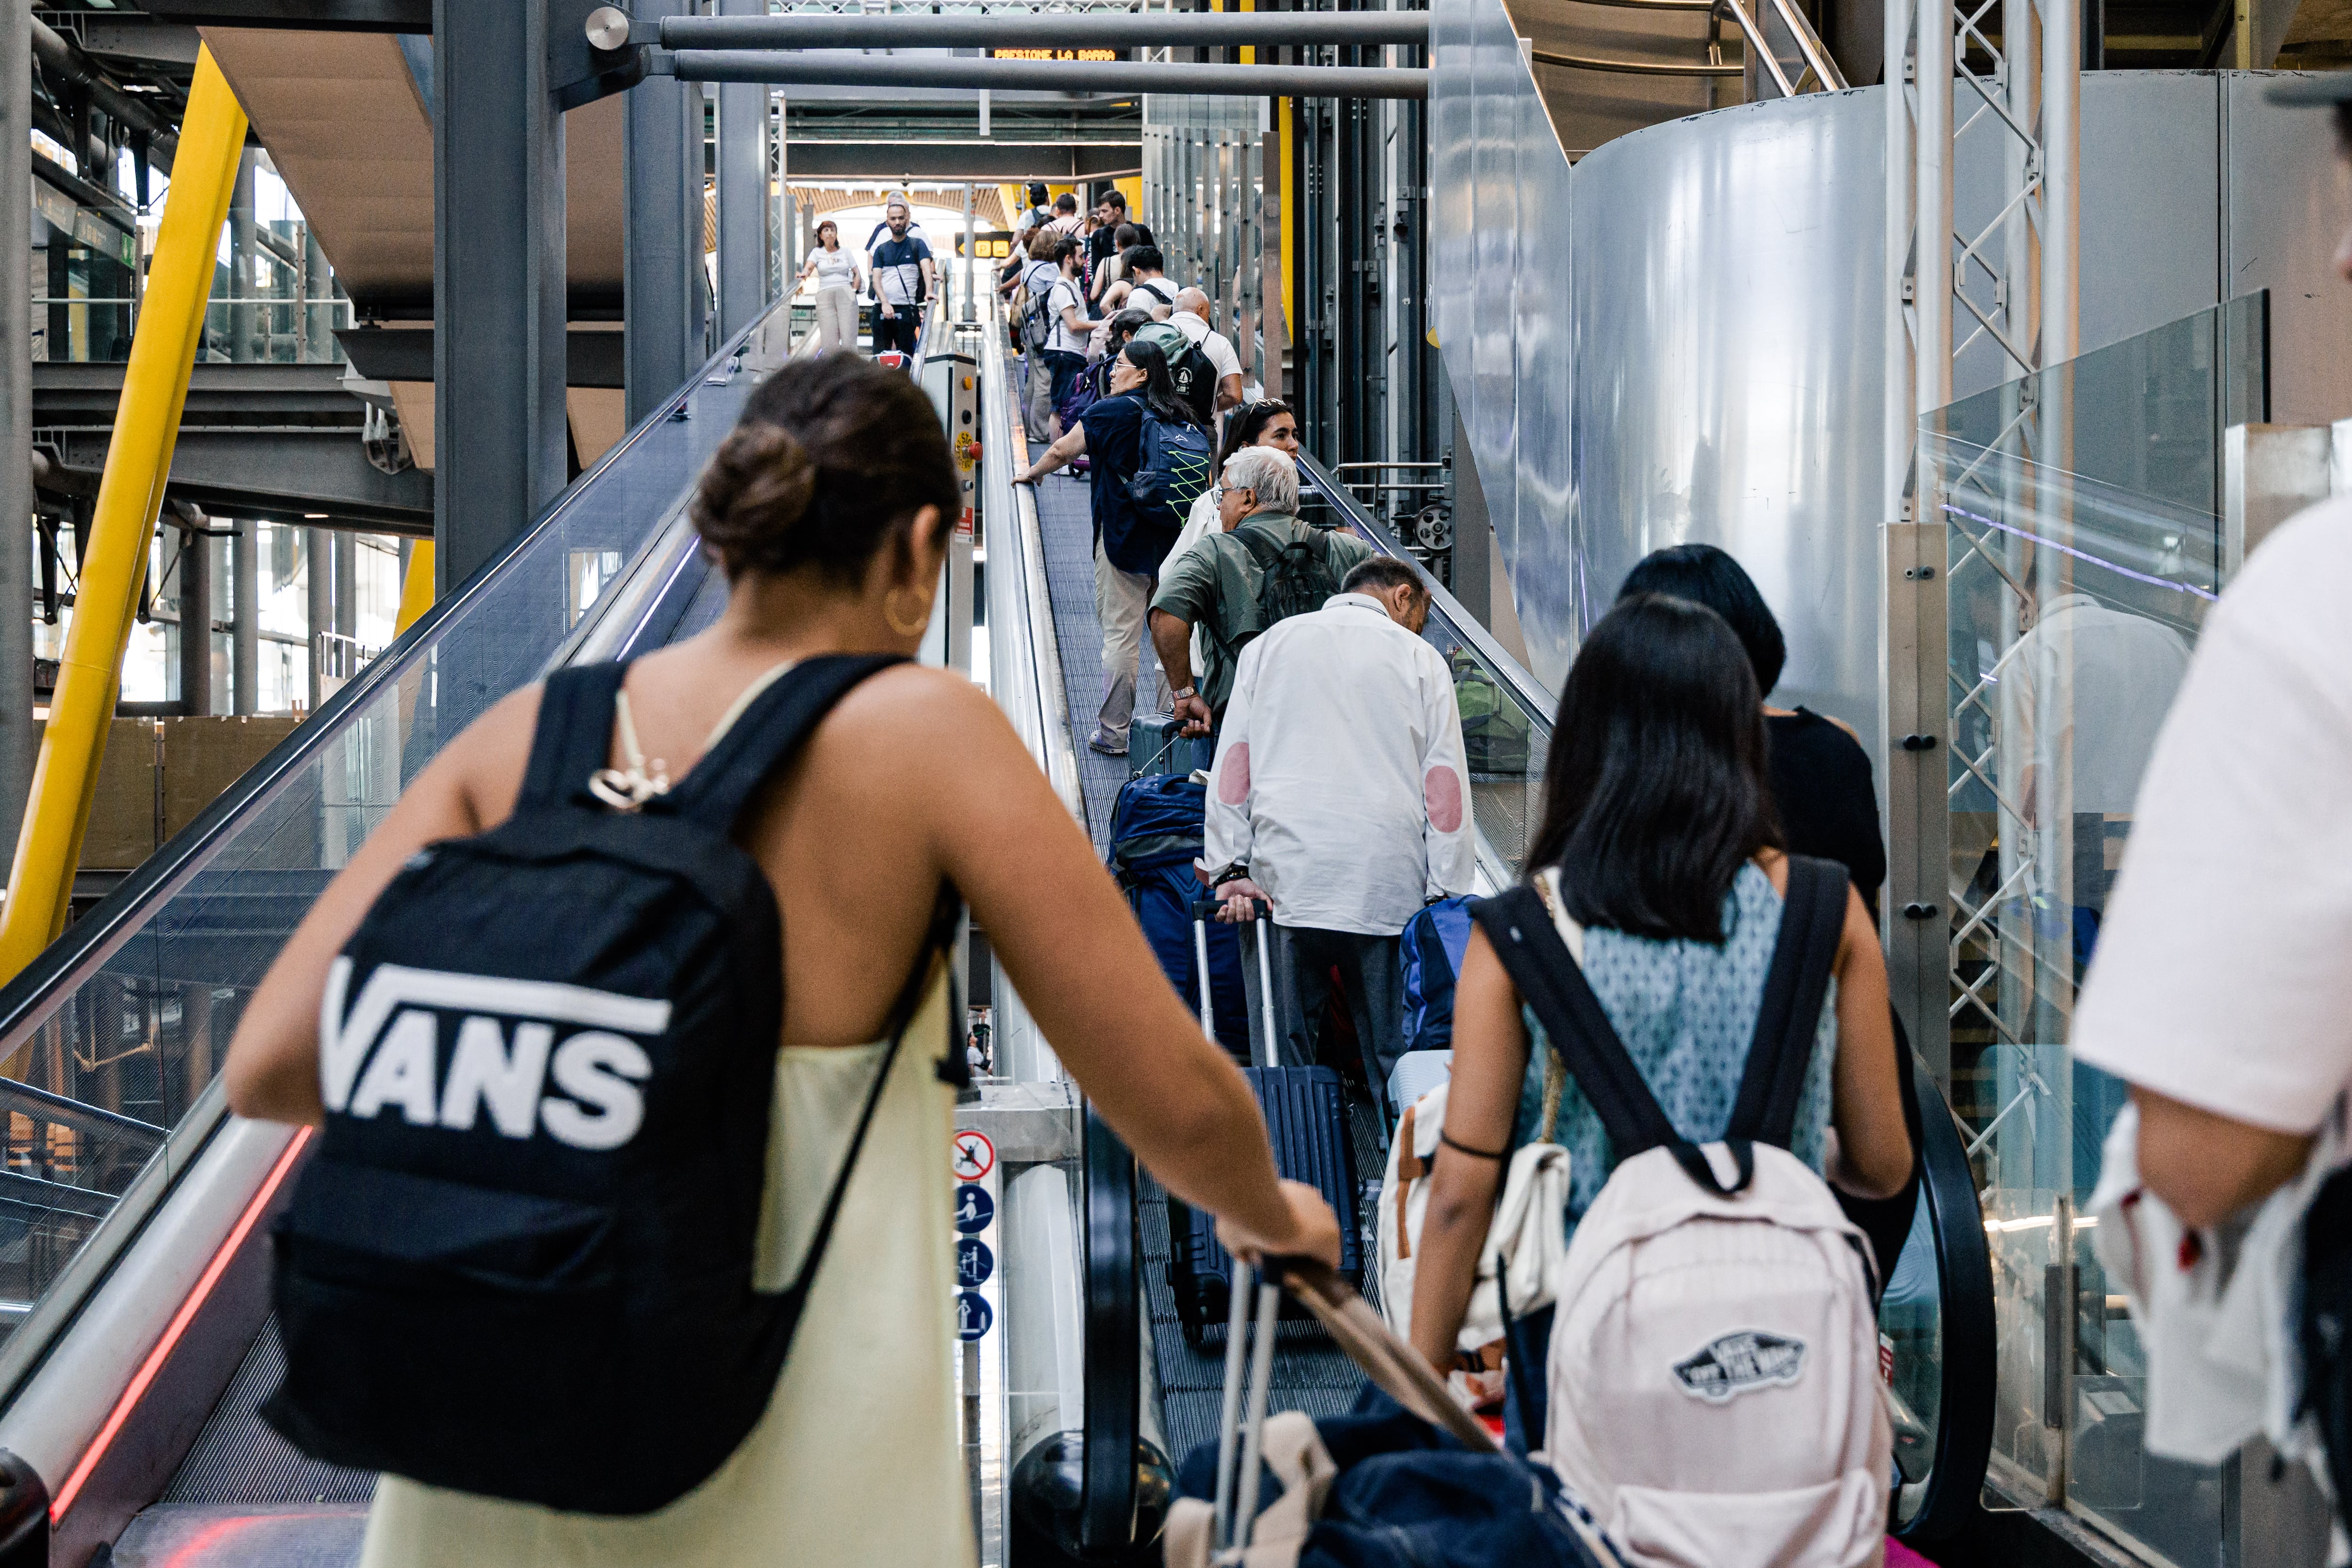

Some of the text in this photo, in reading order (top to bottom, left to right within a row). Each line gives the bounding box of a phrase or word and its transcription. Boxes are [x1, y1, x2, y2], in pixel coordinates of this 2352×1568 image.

[994, 49, 1115, 61] PRESIONE LA BARRA
[320, 955, 673, 1151] VANS
